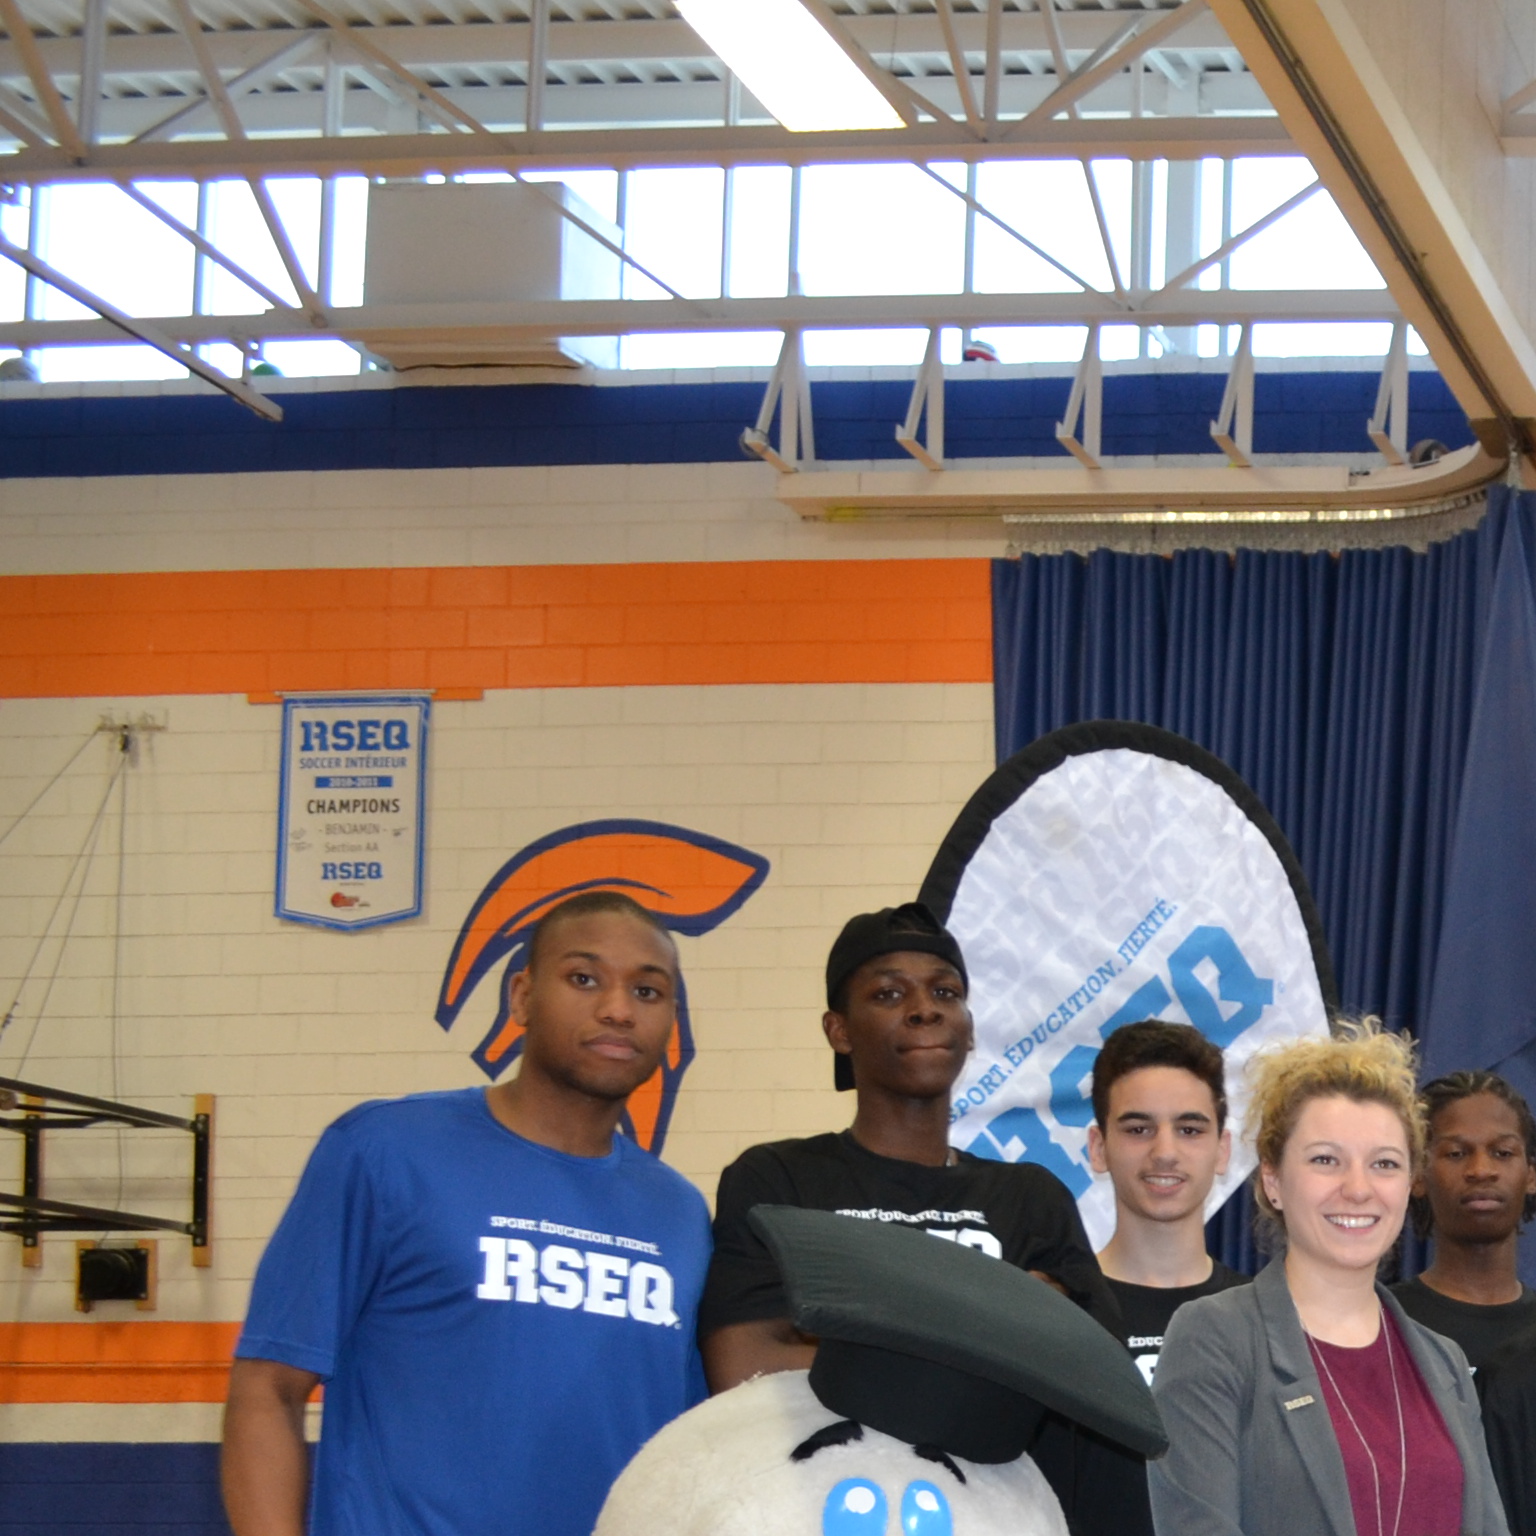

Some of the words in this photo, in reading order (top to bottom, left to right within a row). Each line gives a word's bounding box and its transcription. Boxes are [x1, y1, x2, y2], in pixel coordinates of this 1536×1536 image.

[301, 720, 410, 751] RSEQ
[300, 758, 341, 769] SOCCER
[345, 754, 407, 768] INTÉRIEUR
[307, 799, 400, 814] CHAMPIONS
[325, 823, 380, 835] BENJAMIN
[321, 862, 383, 880] RSEQ
[949, 1063, 1014, 1124] SPORT.
[1003, 959, 1122, 1068] ÉDUCATION.
[1117, 897, 1178, 966] FIERTÉ.
[490, 1216, 540, 1231] SPORT.
[540, 1220, 615, 1246] ÉDUCATION.
[476, 1236, 680, 1327] RSEQ
